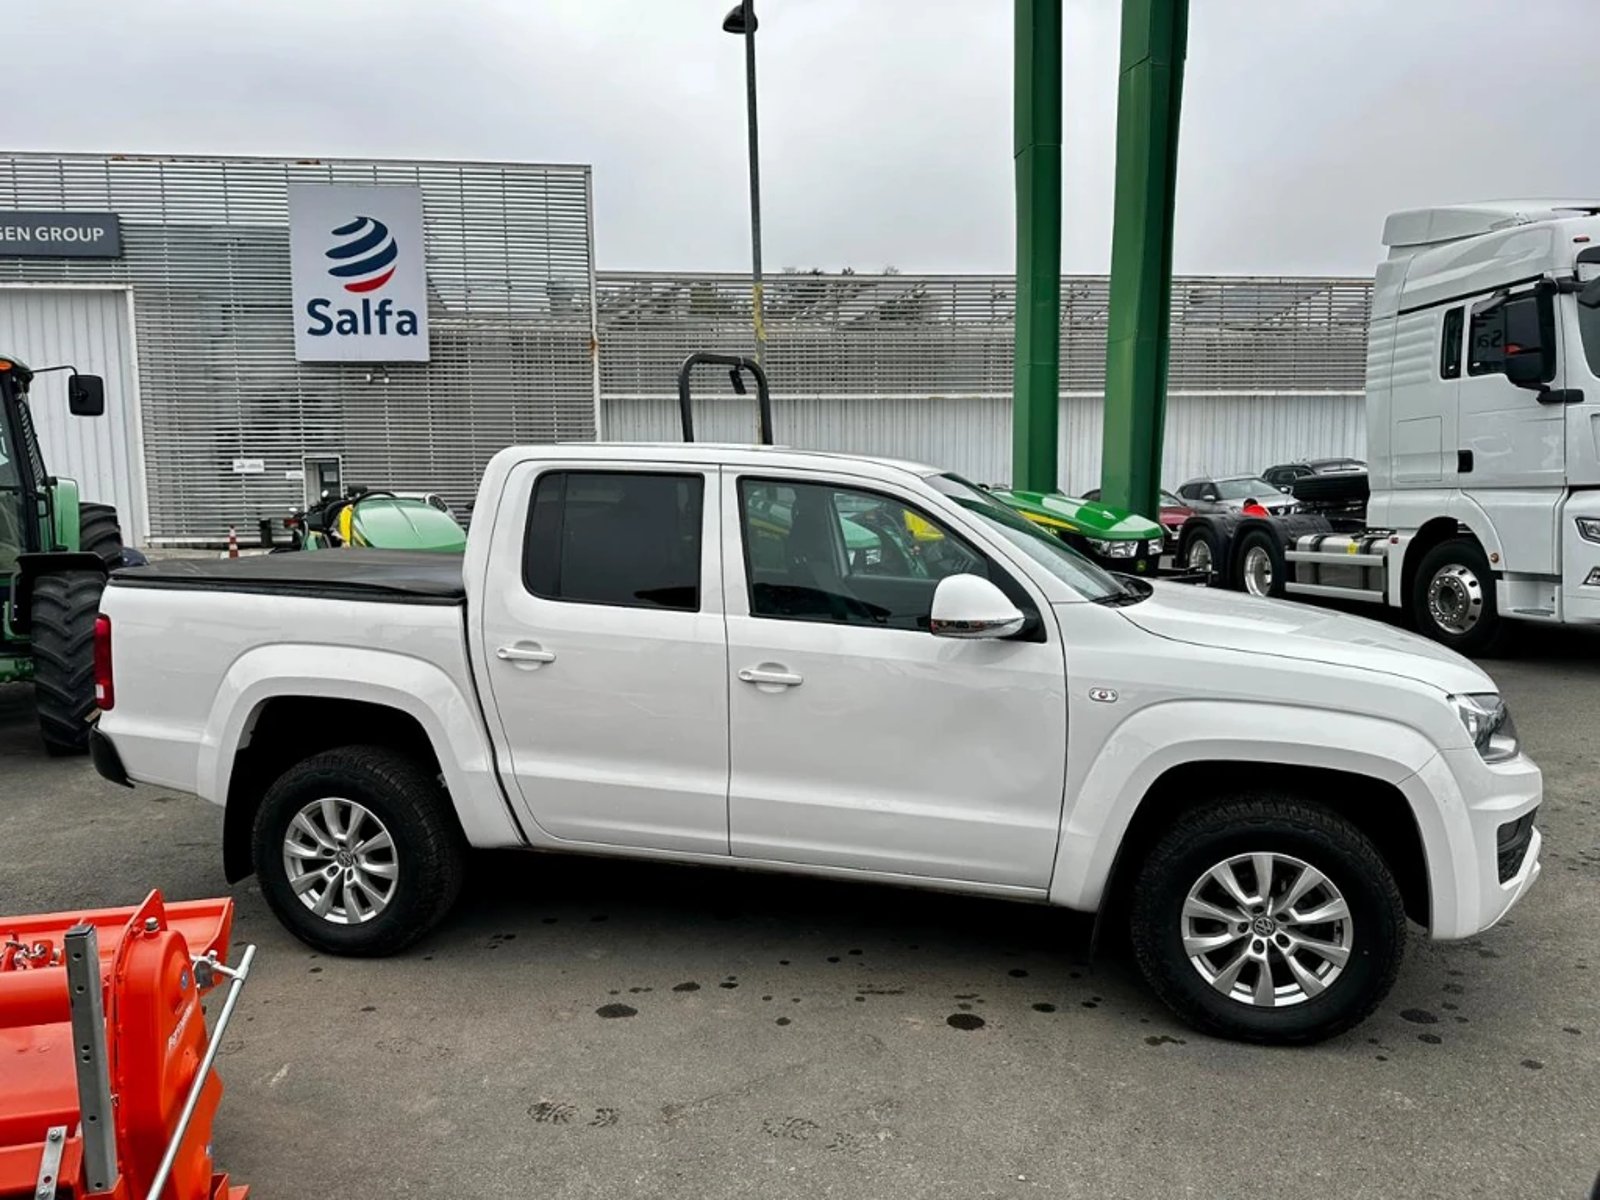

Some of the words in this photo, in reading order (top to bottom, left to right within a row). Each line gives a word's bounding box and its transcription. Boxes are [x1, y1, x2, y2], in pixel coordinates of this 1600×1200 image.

[0, 226, 31, 241] EN
[35, 226, 104, 242] GROUP
[307, 298, 418, 336] Salfa
